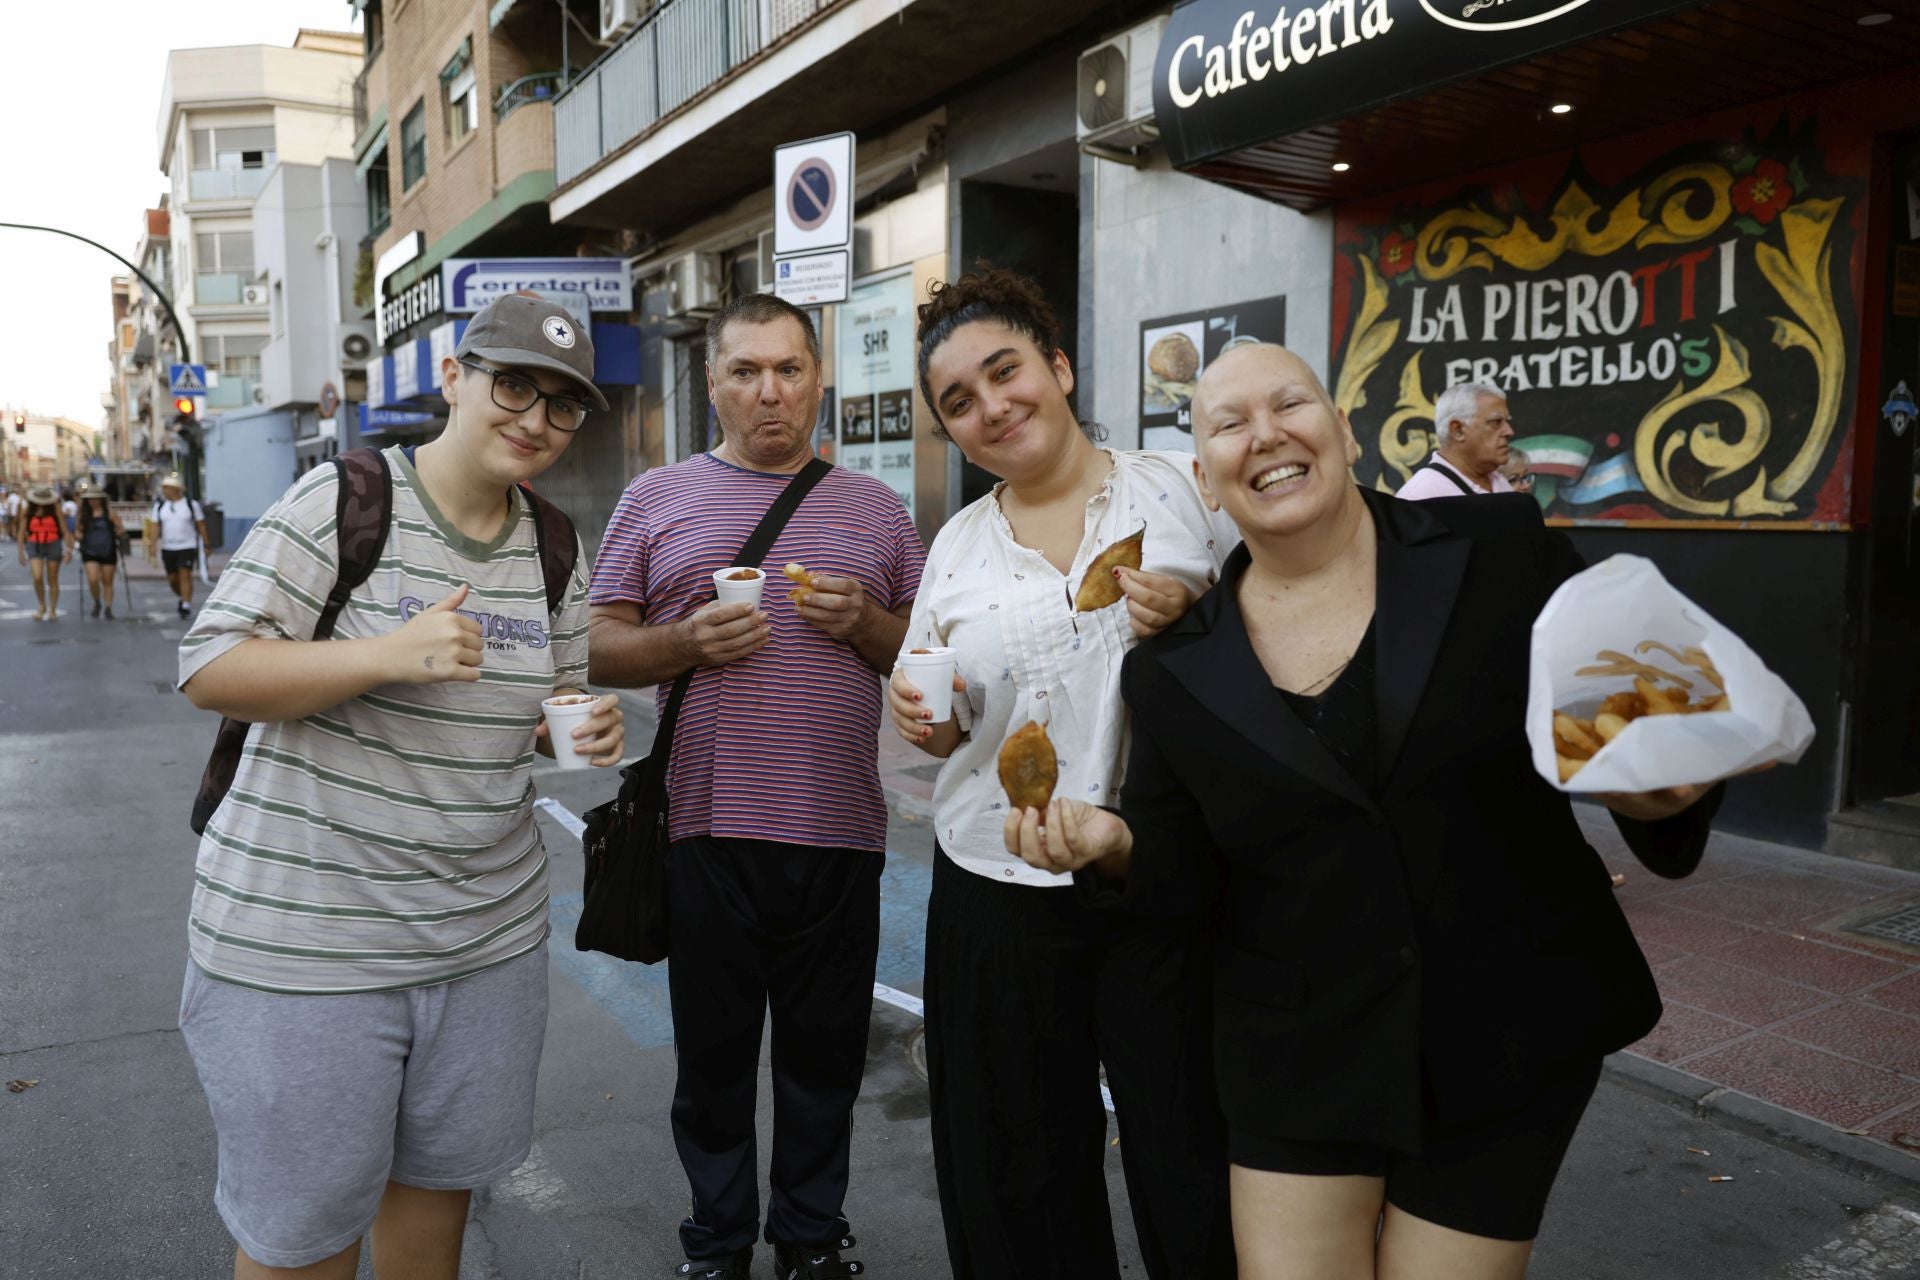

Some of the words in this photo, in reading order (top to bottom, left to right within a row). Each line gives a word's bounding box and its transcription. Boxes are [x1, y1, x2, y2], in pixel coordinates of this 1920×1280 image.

[1406, 286, 1468, 342] LA
[1481, 238, 1738, 342] PIEROTTI
[864, 329, 889, 356] SHR
[486, 641, 517, 651] TOKYO
